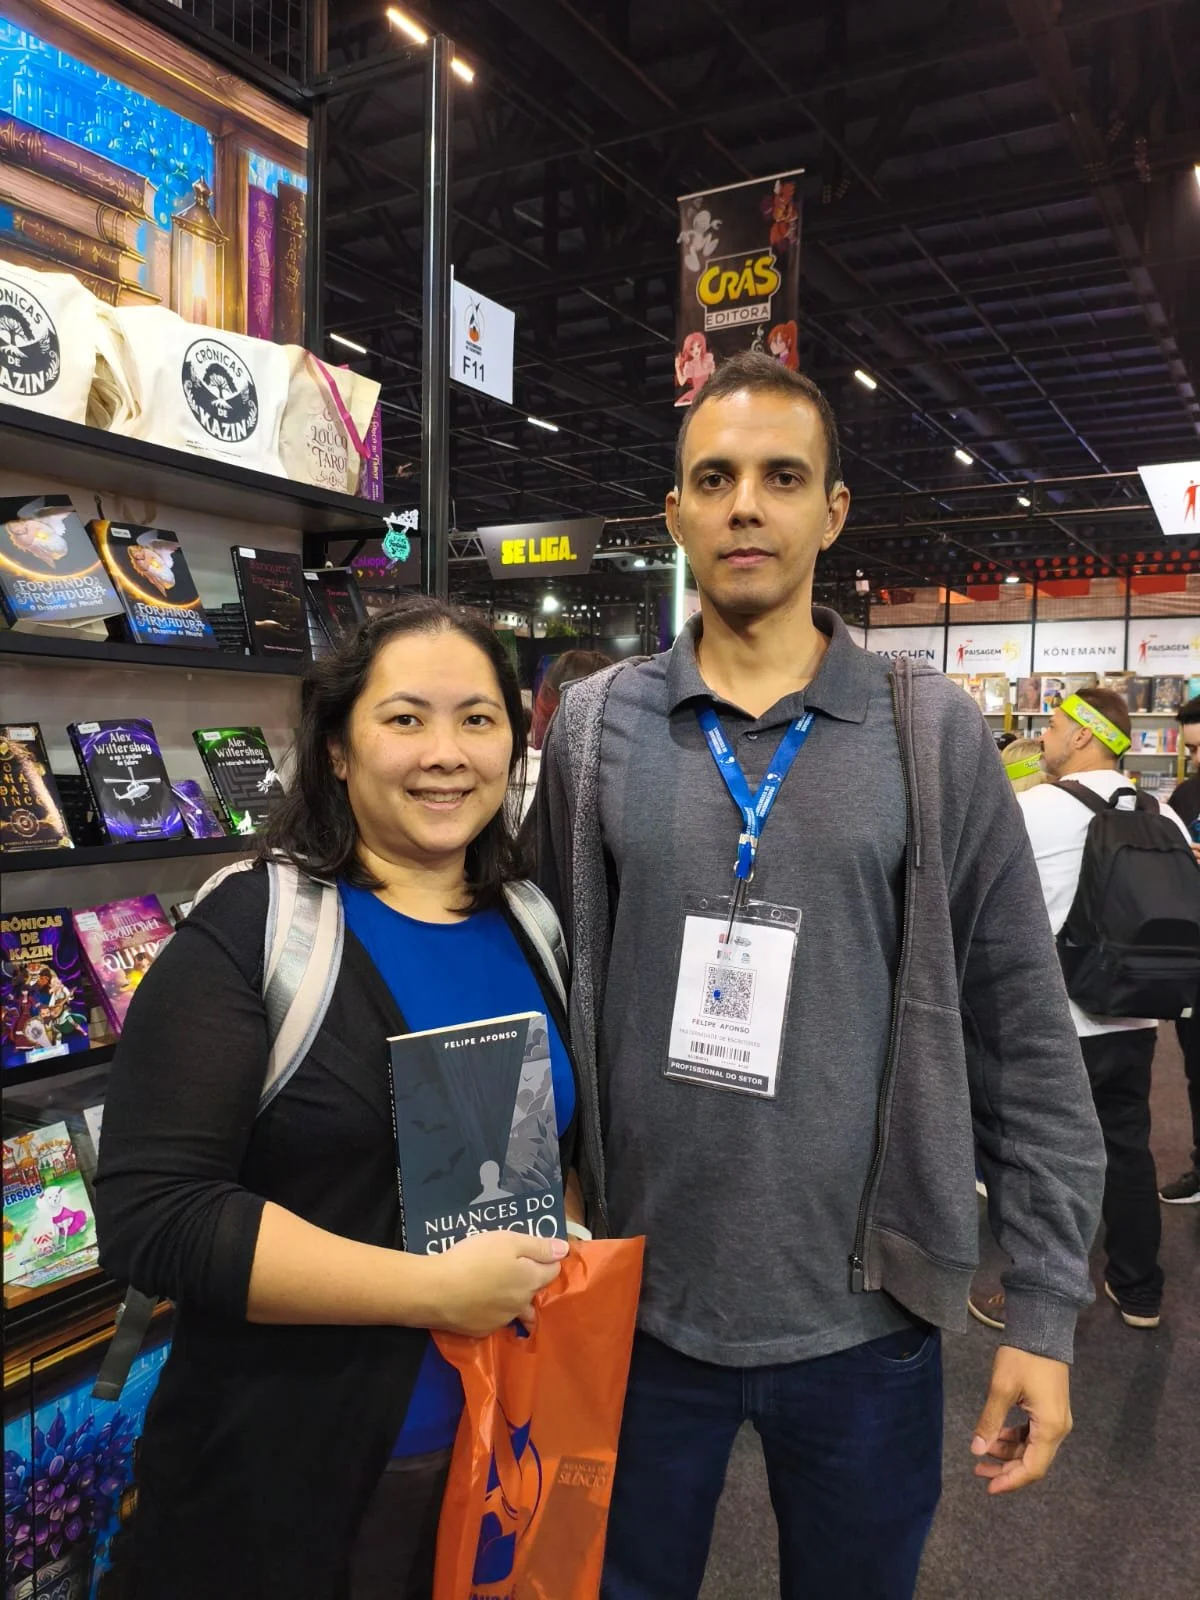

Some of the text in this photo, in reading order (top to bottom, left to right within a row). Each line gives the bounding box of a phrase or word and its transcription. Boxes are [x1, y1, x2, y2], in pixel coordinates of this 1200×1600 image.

[698, 256, 778, 305] CRÁS
[706, 307, 768, 326] EDITORA
[7, 356, 21, 368] DE
[195, 344, 242, 378] CRÔNICAS
[463, 355, 485, 382] F11
[0, 366, 45, 394] AZIN
[217, 407, 229, 418] DE
[199, 406, 247, 441] KAZIN
[310, 425, 348, 450] LOUCO
[501, 535, 578, 565] SE LIGA.
[110, 732, 131, 743] Alex
[227, 737, 246, 748] Alex
[0, 915, 63, 932] RÔNICAS
[20, 931, 40, 945] DE
[9, 944, 53, 960] KAZIN
[691, 1018, 750, 1034] FELIPE AFONSO
[444, 1030, 518, 1049] FELIPE AFONSO
[670, 1061, 724, 1078] PROFISSIONAL
[725, 1072, 737, 1080] DO
[738, 1074, 763, 1085] SETOR
[425, 1194, 555, 1235] NUANCES DO
